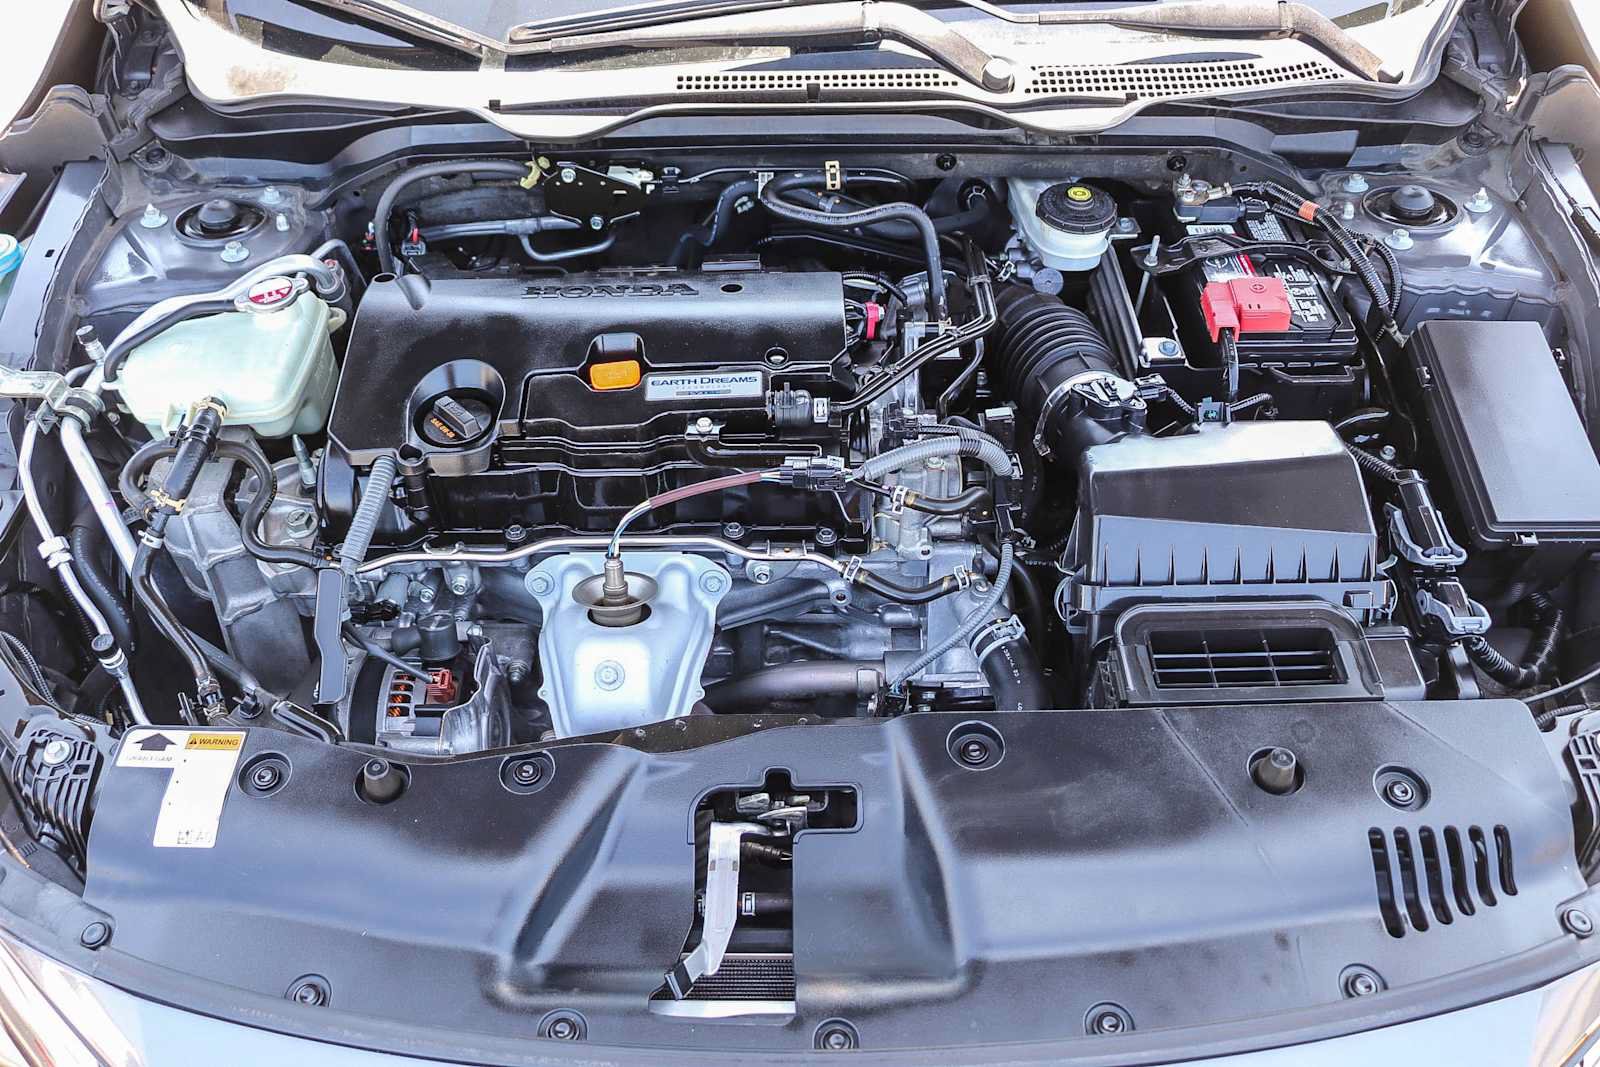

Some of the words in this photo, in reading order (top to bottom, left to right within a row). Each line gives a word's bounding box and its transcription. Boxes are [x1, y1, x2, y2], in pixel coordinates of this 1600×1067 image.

[521, 283, 699, 299] HONDA
[651, 378, 697, 386] EARTH
[700, 376, 757, 384] DREAMS
[199, 738, 239, 746] WARNING
